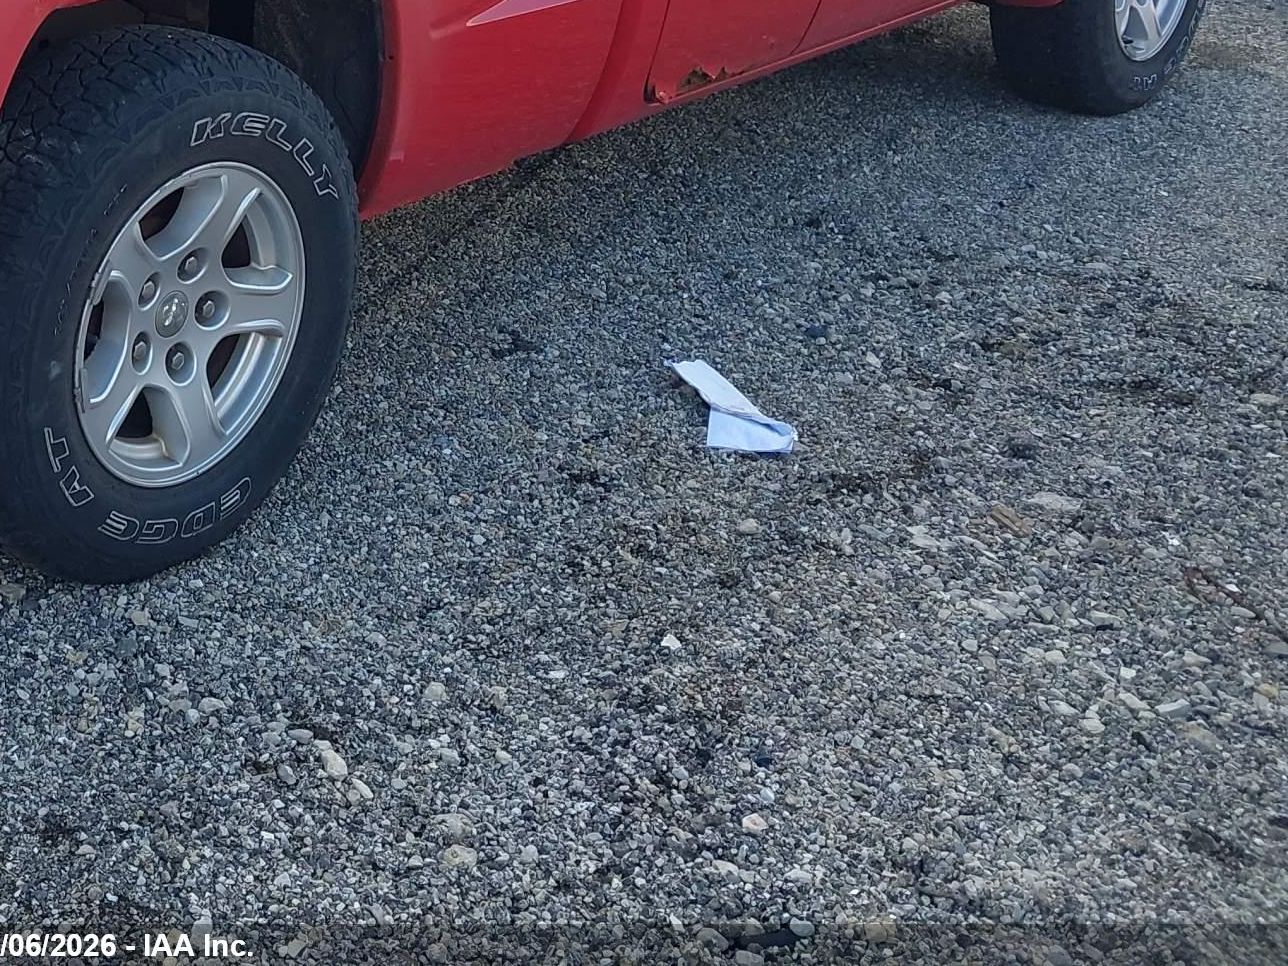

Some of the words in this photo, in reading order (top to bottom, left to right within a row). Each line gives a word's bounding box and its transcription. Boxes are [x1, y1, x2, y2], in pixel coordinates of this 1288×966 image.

[190, 112, 339, 199] KELLY
[44, 427, 95, 507] AT
[97, 476, 252, 544] EDGE
